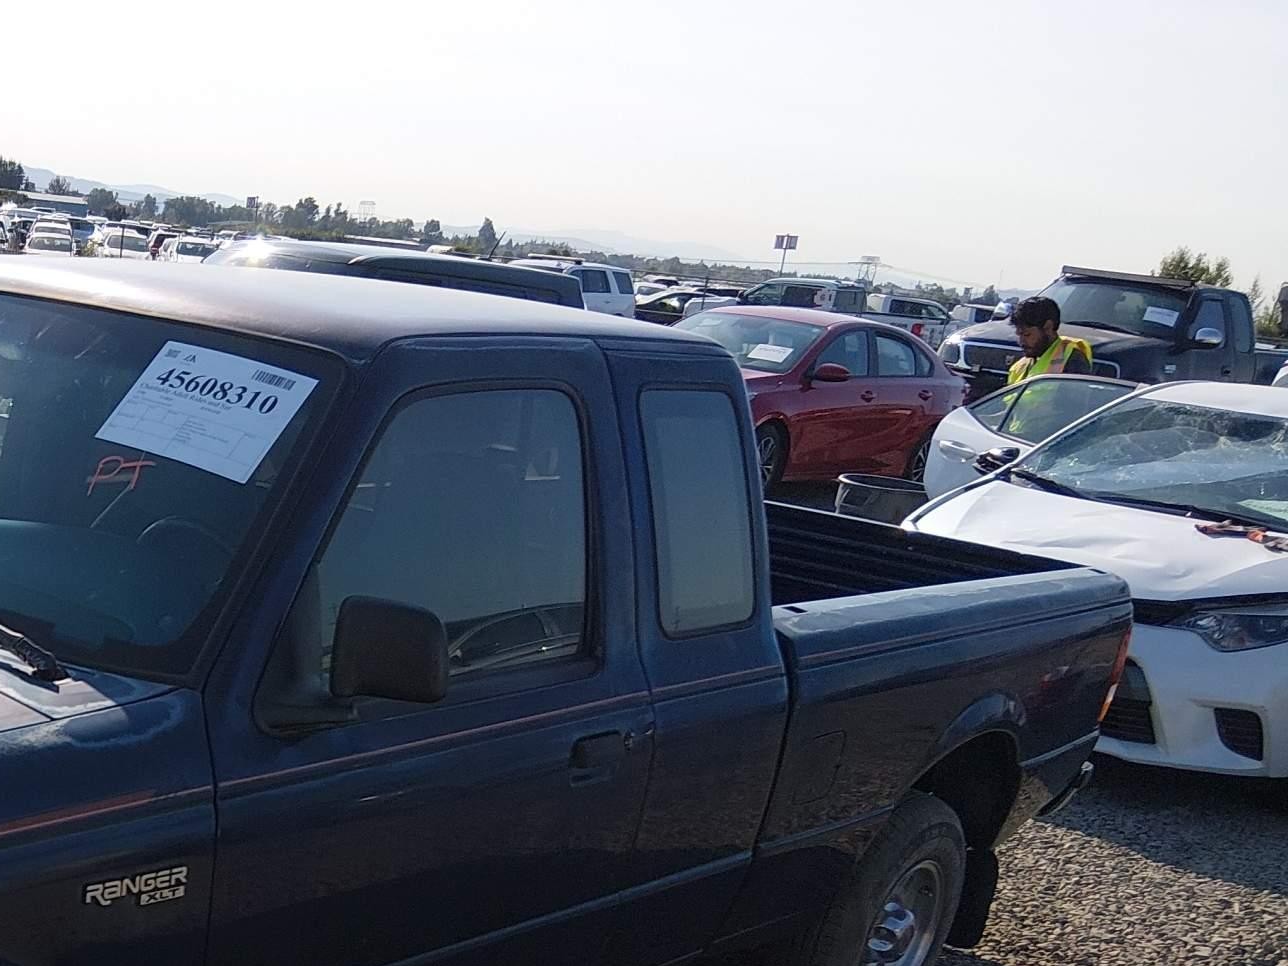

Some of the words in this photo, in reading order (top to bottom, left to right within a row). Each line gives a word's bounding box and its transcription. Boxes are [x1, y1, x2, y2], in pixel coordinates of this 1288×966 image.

[156, 368, 279, 414] 45608310
[85, 866, 188, 906] RANGER
[144, 887, 181, 904] XLT
